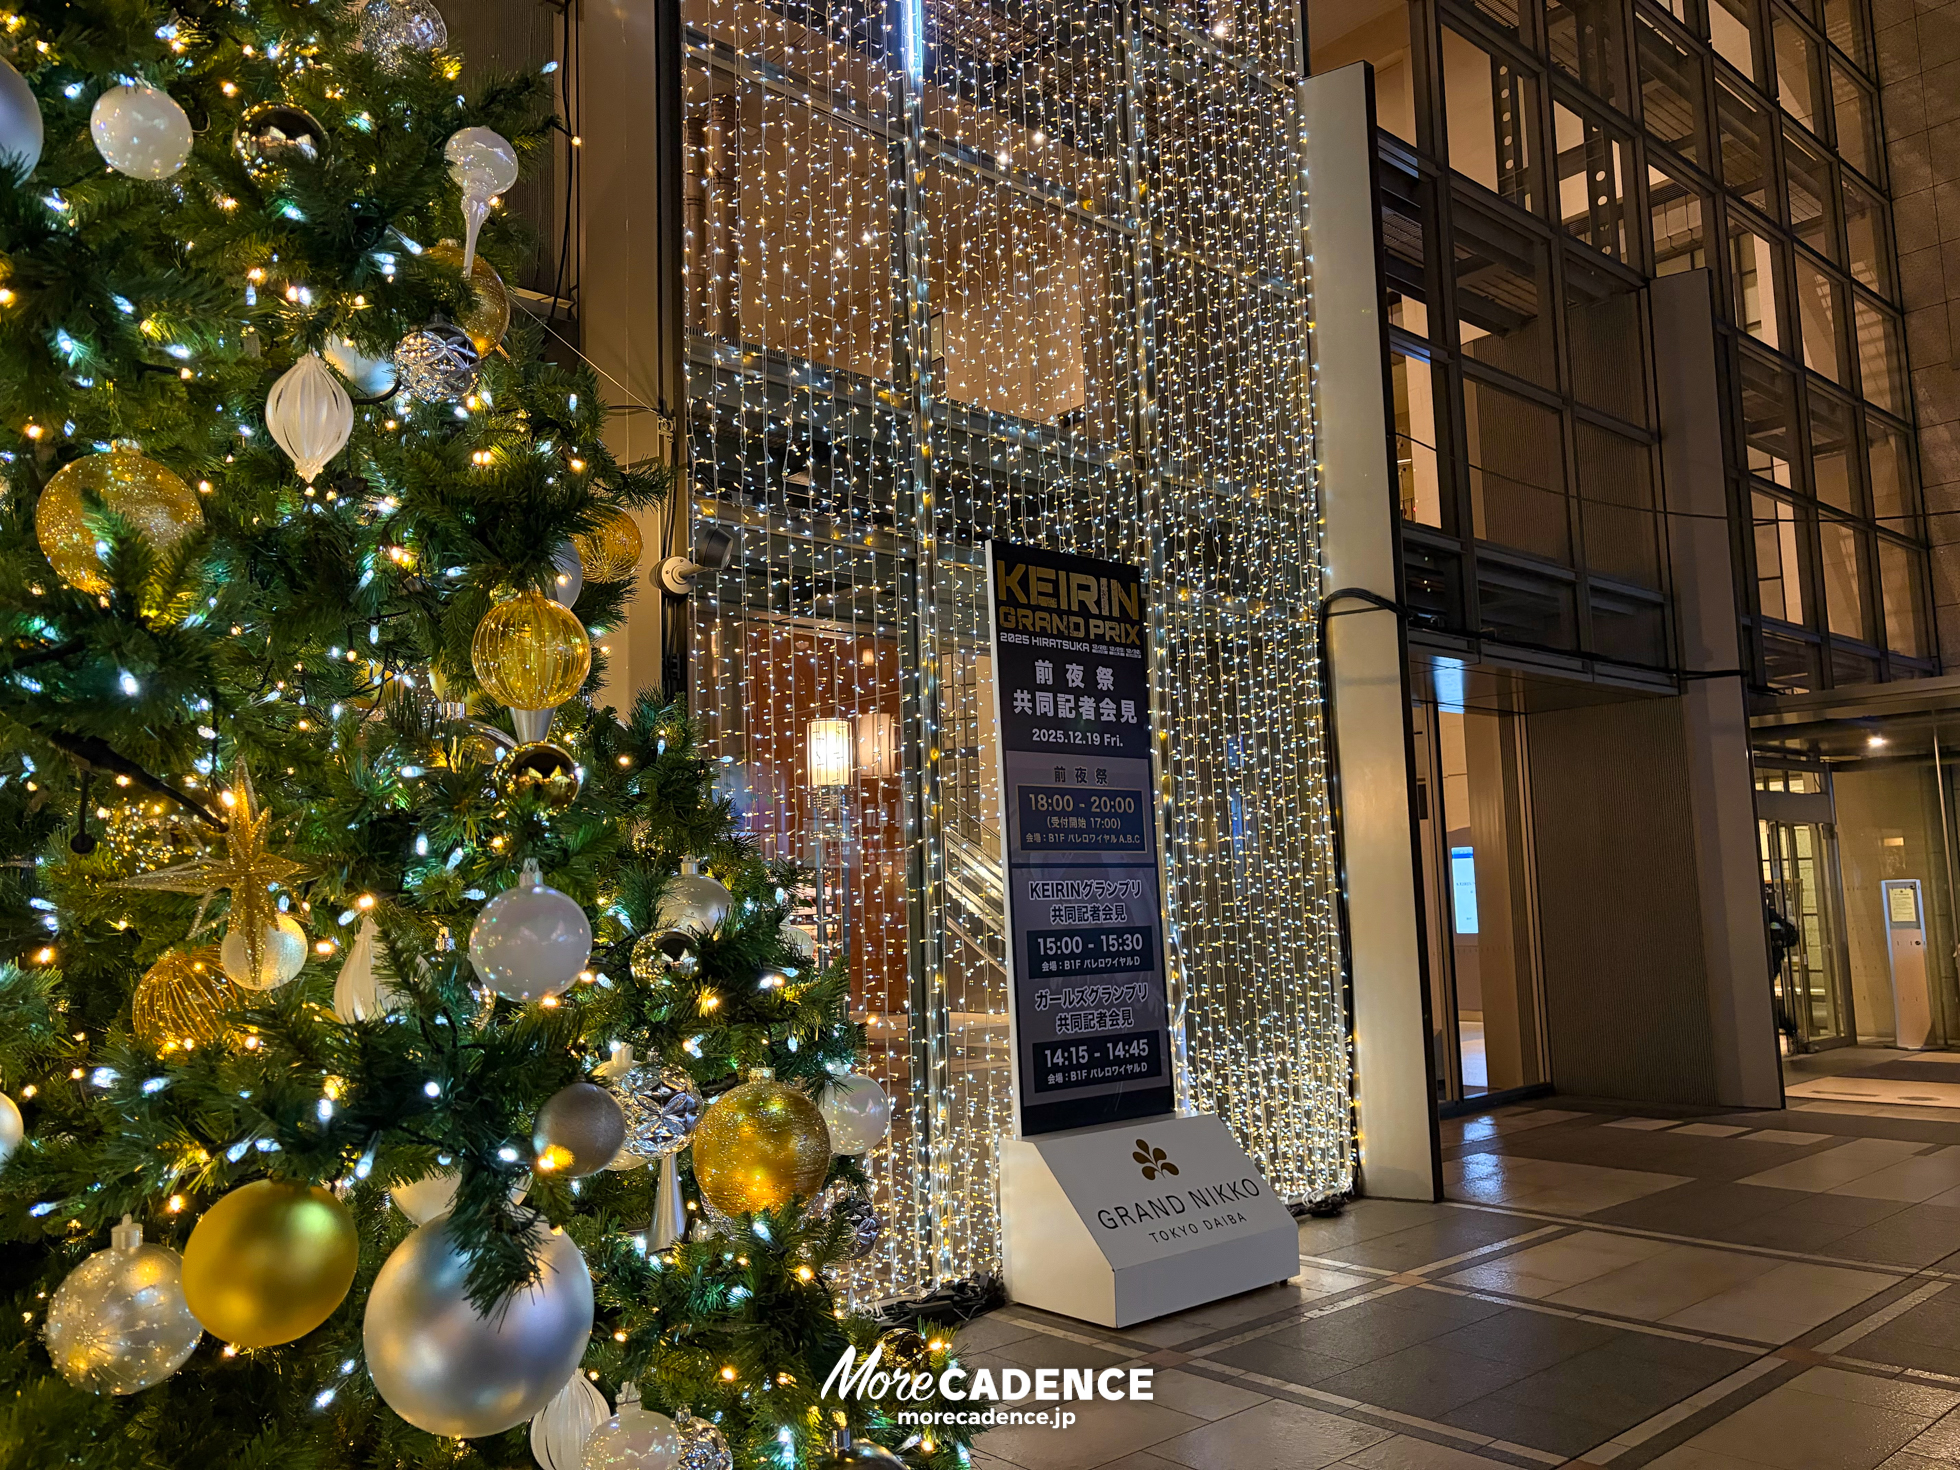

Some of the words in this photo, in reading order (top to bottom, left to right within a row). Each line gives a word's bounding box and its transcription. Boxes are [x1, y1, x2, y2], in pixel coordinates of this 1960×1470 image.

[996, 560, 1139, 620] KEIRIN
[999, 606, 1085, 638] GRAND
[1089, 619, 1141, 645] PRIX
[1000, 632, 1029, 645] 2025
[1013, 689, 1137, 724] 共同記者会見
[1032, 728, 1100, 745] 2025.12.19
[1104, 734, 1123, 747] Fri.
[1029, 794, 1073, 812] 18:00
[1091, 796, 1135, 813] 20:00
[1090, 817, 1121, 830] 17:00)
[1029, 879, 1141, 900] KEIRINグランプリ
[1051, 903, 1127, 924] 共同記者会見
[1037, 936, 1082, 955] 15:00
[1100, 934, 1143, 952] 15:30
[1035, 983, 1148, 1011] ガールズグランプリ
[1056, 1008, 1134, 1034] 共同記者会見
[1045, 1046, 1088, 1067] 14:15
[1107, 1039, 1149, 1060] 14:45
[1097, 1195, 1185, 1229] GRAND
[1188, 1178, 1260, 1209] NIKKO
[1149, 1223, 1199, 1243] TOKYO
[1203, 1212, 1247, 1230] DAIBA
